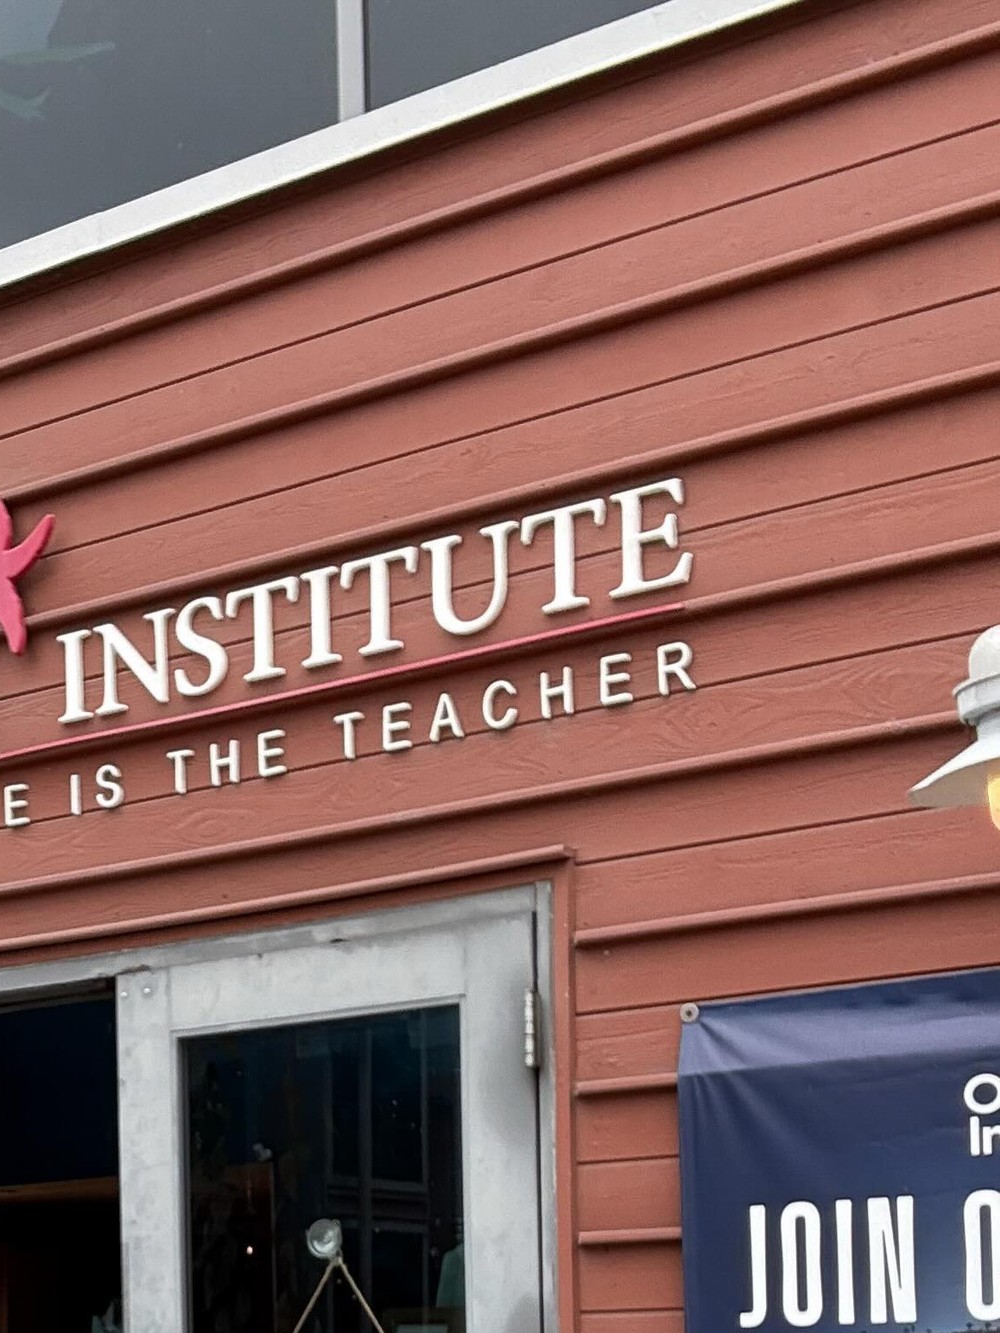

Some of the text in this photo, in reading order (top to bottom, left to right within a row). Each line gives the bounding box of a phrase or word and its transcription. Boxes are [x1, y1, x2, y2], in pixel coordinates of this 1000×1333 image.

[57, 478, 695, 725] INSTITUTE
[69, 764, 124, 817] IS
[167, 729, 286, 794] THE
[334, 641, 696, 759] TEACHER
[739, 1195, 917, 1329] JOIN
